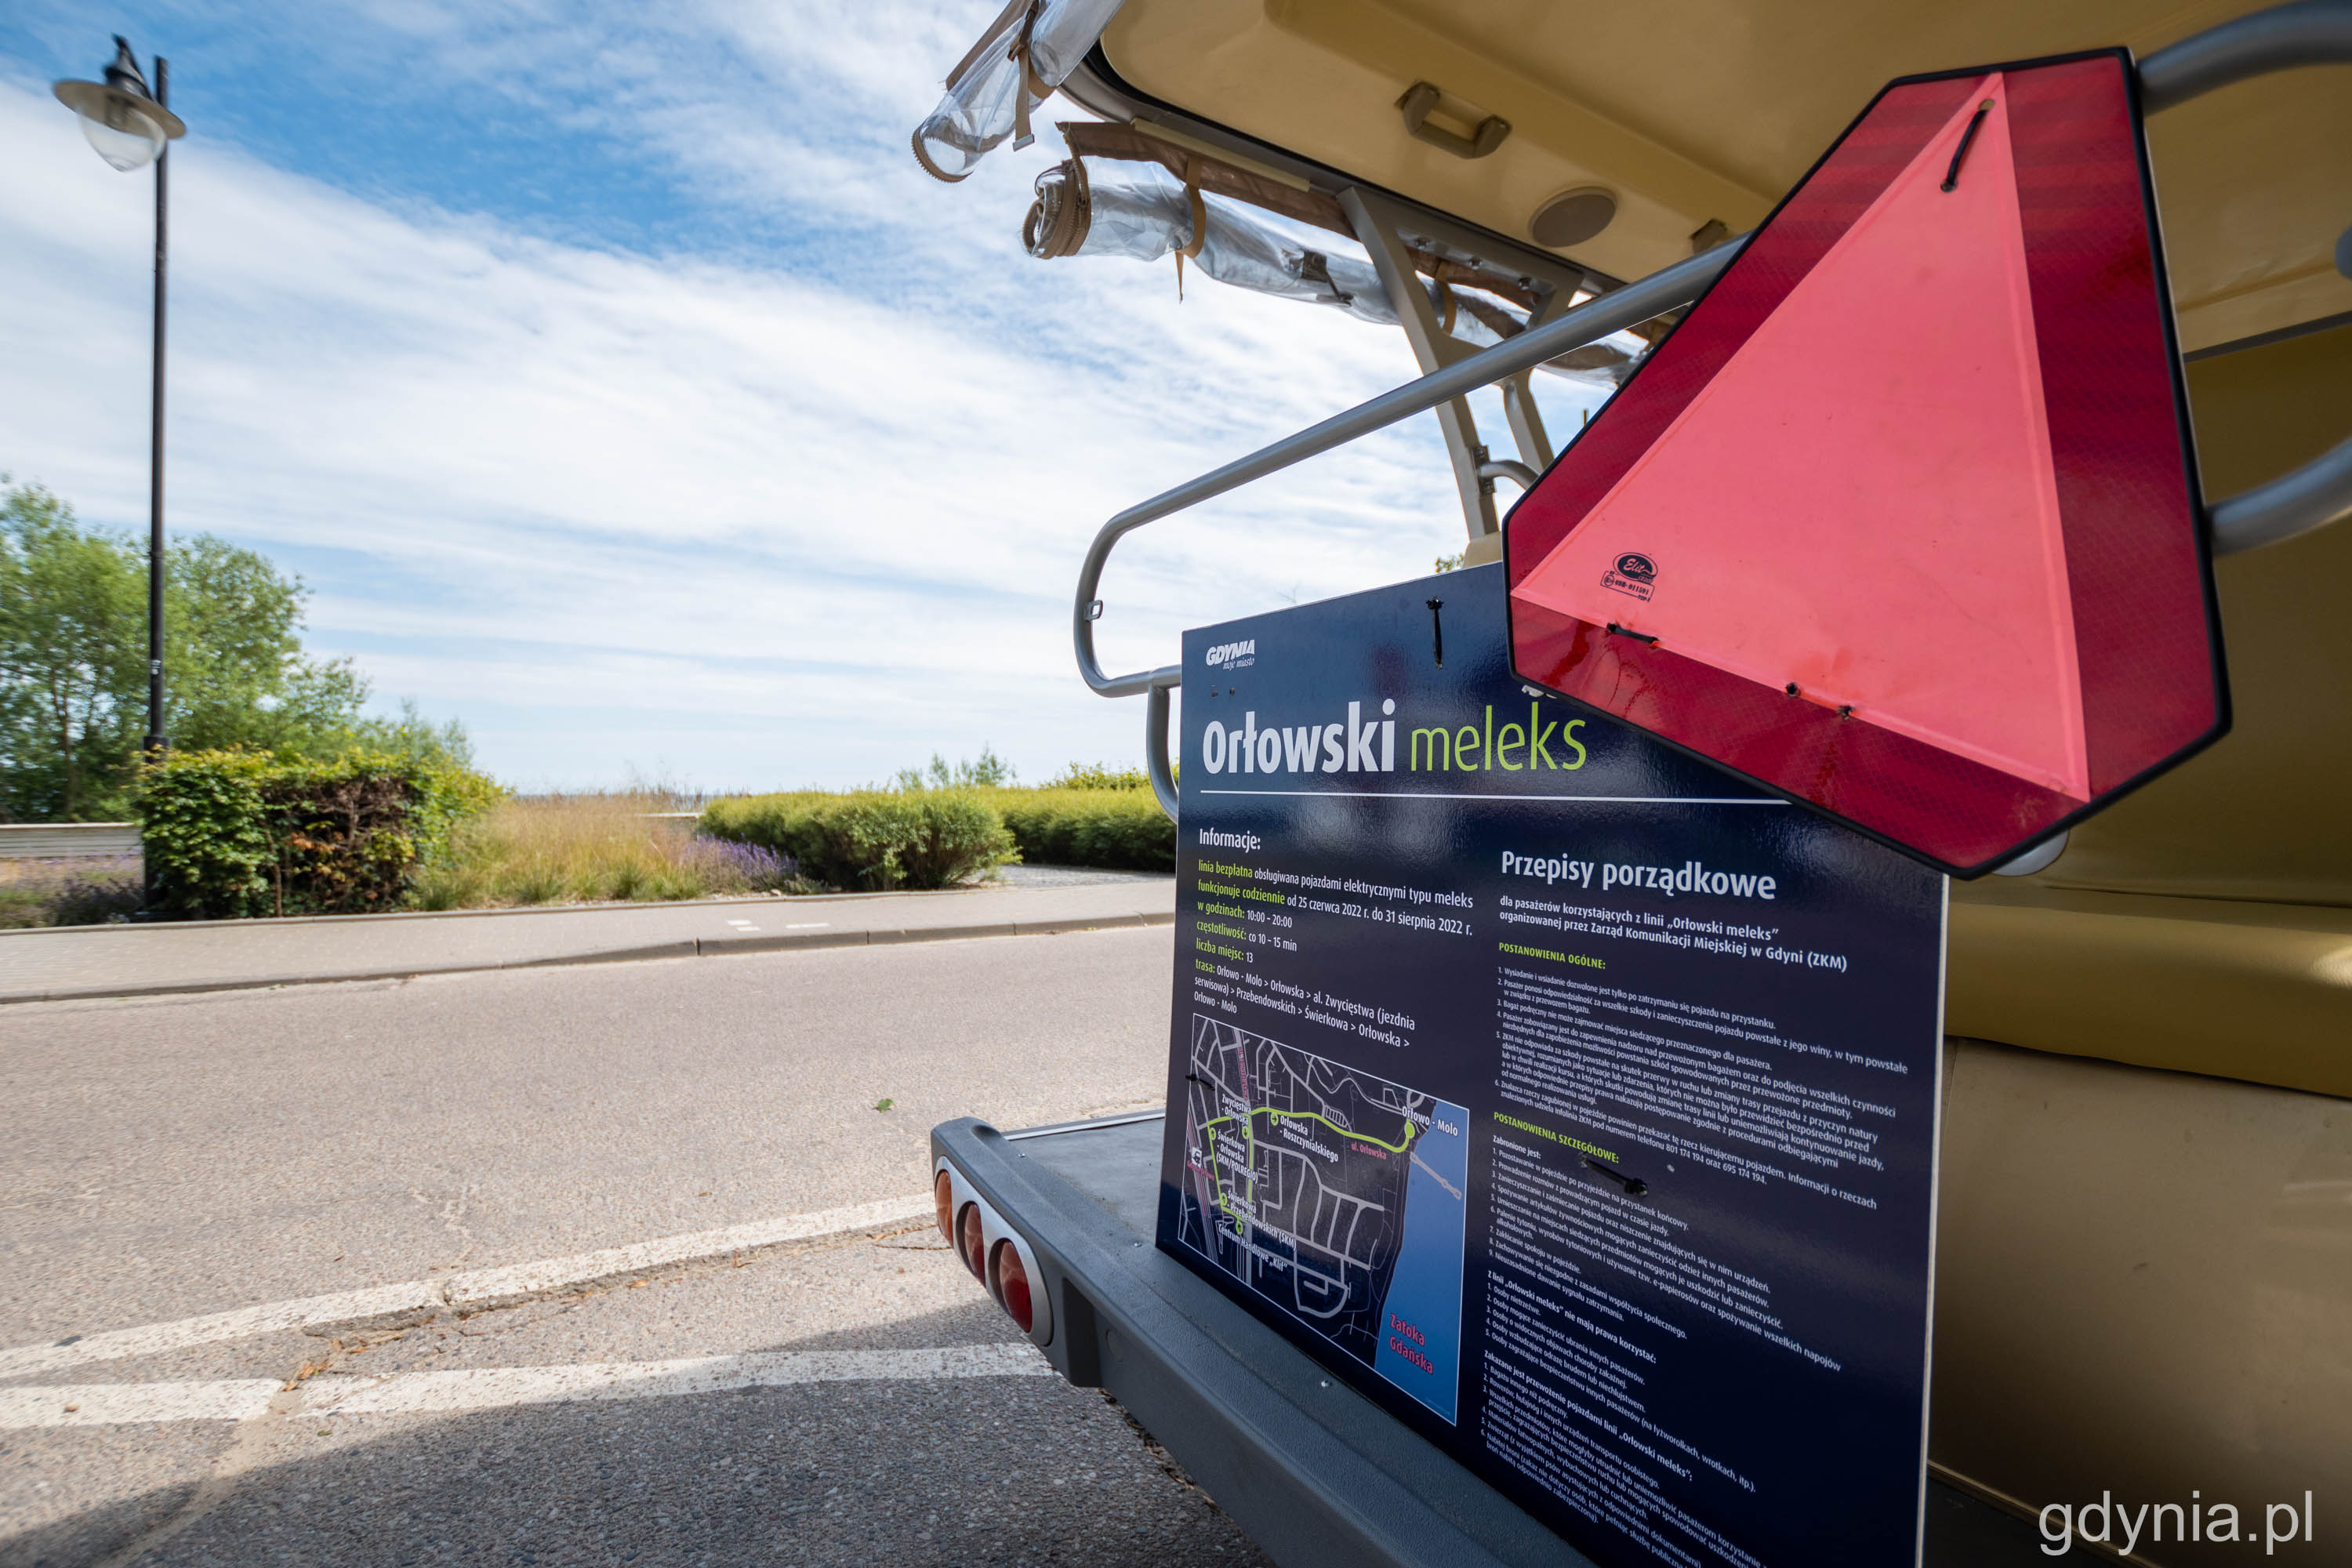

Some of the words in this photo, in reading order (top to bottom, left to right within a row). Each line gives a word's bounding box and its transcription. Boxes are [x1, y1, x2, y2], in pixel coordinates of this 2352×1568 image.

[1206, 639, 1255, 666] GDYNIA
[1203, 699, 1396, 774] Orłowski
[1411, 702, 1587, 771] meleks
[1200, 827, 1261, 853] Informacje:
[1198, 858, 1214, 873] linia
[1215, 861, 1253, 878] bezpłatna
[1254, 867, 1299, 884] obsługiwana
[1301, 874, 1341, 890] pojazdami
[1343, 878, 1406, 901] elektrycznymi
[1409, 887, 1432, 905] typu
[1434, 891, 1473, 908] meleks
[1501, 851, 1595, 888] Przepisy
[1602, 861, 1776, 899] porządkowe
[1197, 901, 1204, 910] w
[1205, 901, 1245, 919] godzinach:
[1247, 909, 1265, 923] 10:00
[1272, 913, 1292, 928] 20:00
[1198, 878, 1240, 899] funkcjonuje
[1242, 887, 1285, 905] codziennie
[1287, 894, 1297, 906] od
[1298, 896, 1307, 909] 25
[1308, 899, 1340, 914] czerwca
[1341, 902, 1362, 917] 2022
[1363, 908, 1370, 919] r.
[1371, 906, 1383, 921] do
[1385, 909, 1396, 923] 31
[1398, 911, 1436, 930] sierpnia
[1438, 917, 1462, 934] 2022
[1465, 924, 1472, 935] r.
[1500, 895, 1513, 906] dla
[1515, 899, 1560, 913] pasażerów
[1563, 902, 1632, 924] korzystających
[1635, 914, 1641, 924] z
[1643, 912, 1664, 926] linii
[1667, 916, 1722, 935] „Orłowski
[1726, 924, 1779, 941] meleks”
[1196, 921, 1247, 940] częstotliwość:
[1248, 932, 1257, 942] co
[1258, 933, 1266, 945] 10
[1272, 936, 1281, 948] 15
[1282, 938, 1297, 952] min
[1196, 937, 1216, 953] liczba
[1218, 944, 1244, 960] miejsc:
[1246, 951, 1254, 963] 13
[1499, 911, 1562, 930] organizowanej
[1563, 920, 1588, 931] przez
[1590, 922, 1623, 938] Zarząd
[1625, 927, 1690, 949] Komunikacji
[1693, 936, 1747, 957] Miejskiej
[1751, 946, 1762, 956] w
[1766, 946, 1802, 964] Gdyni
[1807, 951, 1847, 972] (ZKM)
[1498, 942, 1566, 962] POSTANOWIENIA
[1568, 953, 1606, 969] OGÓLNE:
[1194, 990, 1215, 1007] Orłowo
[1221, 999, 1237, 1014] Molo
[1196, 958, 1215, 973] trasa:
[1216, 965, 1240, 980] Orłowo
[1245, 972, 1262, 987] Molo
[1270, 979, 1304, 999] Orłowska
[1312, 990, 1323, 1004] al.
[1325, 993, 1374, 1019] Zwycięstwa
[1377, 1007, 1415, 1030] (jezdnia
[1504, 967, 1534, 980] Wysiadanie
[1537, 975, 1566, 986] wsiadanie
[1566, 979, 1598, 993] dozwolone
[1599, 985, 1610, 996] jest
[1611, 989, 1628, 999] tylko
[1628, 993, 1637, 1001] po
[1638, 995, 1679, 1009] zatrzymaniu
[1679, 1002, 1690, 1013] się
[1690, 1005, 1719, 1018] pojazdu
[1720, 1011, 1730, 1020] na
[1731, 1014, 1776, 1029] przystanku.
[1194, 976, 1229, 996] serwisowa)
[1236, 987, 1296, 1014] Przebendowskich
[1304, 1004, 1348, 1031] Świerkowa
[1358, 1023, 1401, 1047] Orłowska
[1221, 1094, 1252, 1115] Zwycięstwa
[1225, 1106, 1249, 1126] Orłowska
[1402, 1105, 1430, 1126] Orłowo
[1438, 1118, 1458, 1137] Molo
[1218, 1129, 1245, 1152] Świerkowa
[1279, 1115, 1308, 1136] Orłowska
[1494, 1111, 1557, 1142] POSTANOWIENIA
[1559, 1134, 1619, 1163] SZCZEGÓŁOWE:
[1221, 1143, 1244, 1163] Orłowska
[1283, 1128, 1338, 1163] Roszczynialskiego
[1359, 1144, 1386, 1160] Orłowska
[1493, 1134, 1526, 1154] Zabronione
[1526, 1147, 1541, 1160] jest:
[1216, 1152, 1258, 1184] (SKM/POLREGIO)
[1228, 1189, 1256, 1214] Świerkowa
[1498, 1149, 1534, 1169] Pozostawanie
[1541, 1167, 1568, 1182] pojeździe
[1568, 1177, 1577, 1185] po
[1577, 1180, 1610, 1199] przyjeździe
[1611, 1193, 1620, 1203] na
[1621, 1197, 1656, 1217] przystanek
[1657, 1210, 1689, 1230] końcowy.
[1231, 1203, 1278, 1238] Przebendowskich
[1279, 1232, 1297, 1250] (SKM)
[1218, 1225, 1240, 1243] Centrum
[1242, 1240, 1269, 1263] Handlowe
[1269, 1254, 1287, 1272] „Klif”
[1389, 1313, 1425, 1347] Zatoka
[1487, 1269, 1492, 1279] Z
[1492, 1271, 1504, 1284] linii
[1504, 1279, 1535, 1300] „Orłowski
[1536, 1295, 1563, 1313] meleks”
[1564, 1310, 1576, 1321] nie
[1576, 1316, 1594, 1333] mają
[1595, 1326, 1617, 1344] prawa
[1619, 1336, 1656, 1363] korzystać:
[1389, 1335, 1434, 1375] Gdańska
[1484, 1349, 1512, 1372] Zakazane
[1512, 1366, 1525, 1380] jest
[1526, 1375, 1566, 1404] przewożenie
[1566, 1399, 1602, 1426] pojazdami
[1603, 1419, 1617, 1436] linii
[1618, 1432, 1655, 1458] „Orłowski
[1657, 1454, 1692, 1481] meleks”:
